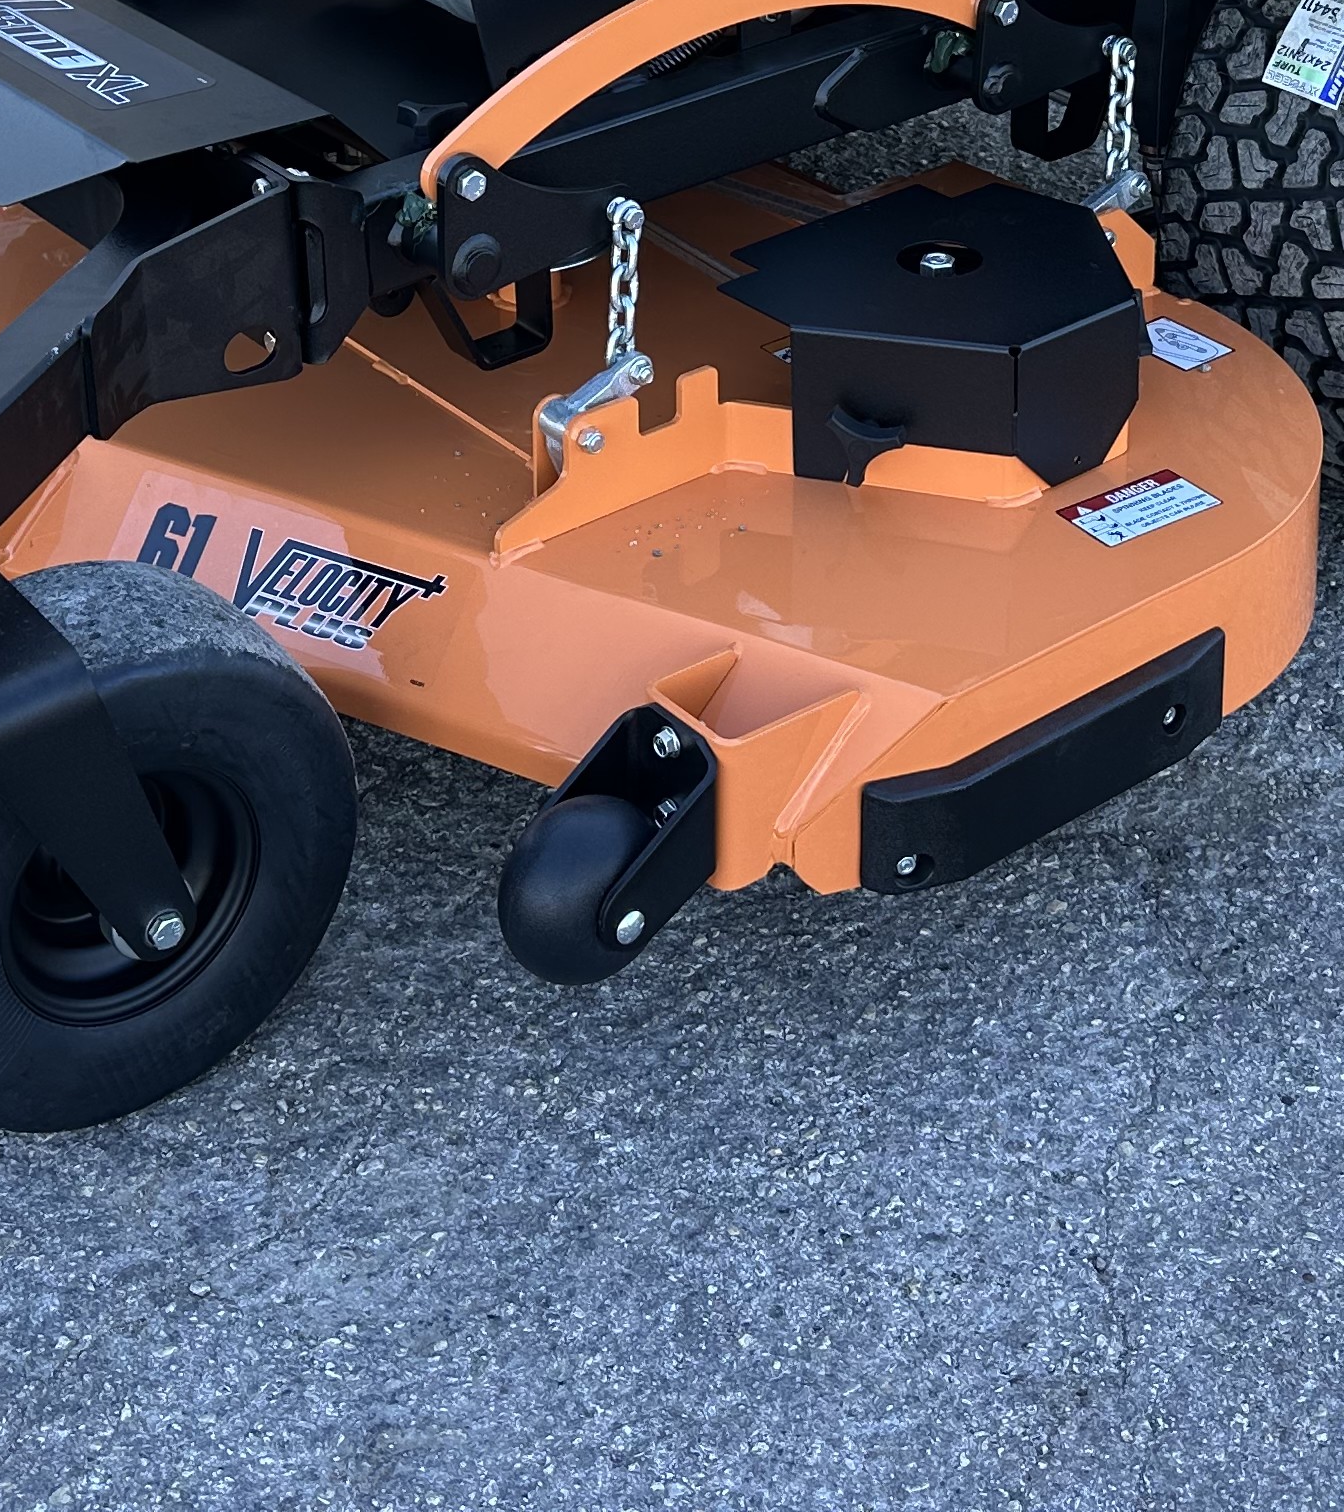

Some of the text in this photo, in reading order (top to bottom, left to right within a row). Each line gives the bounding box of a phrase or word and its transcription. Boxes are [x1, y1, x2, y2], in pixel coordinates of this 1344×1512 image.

[1272, 59, 1302, 76] TURF
[65, 63, 149, 106] XL
[1105, 479, 1160, 504] DANGER
[1112, 483, 1184, 514] SPINNING BLADES
[1138, 496, 1177, 513] KEEP CLEAR
[136, 502, 218, 578] 61
[244, 595, 374, 651] PLUS
